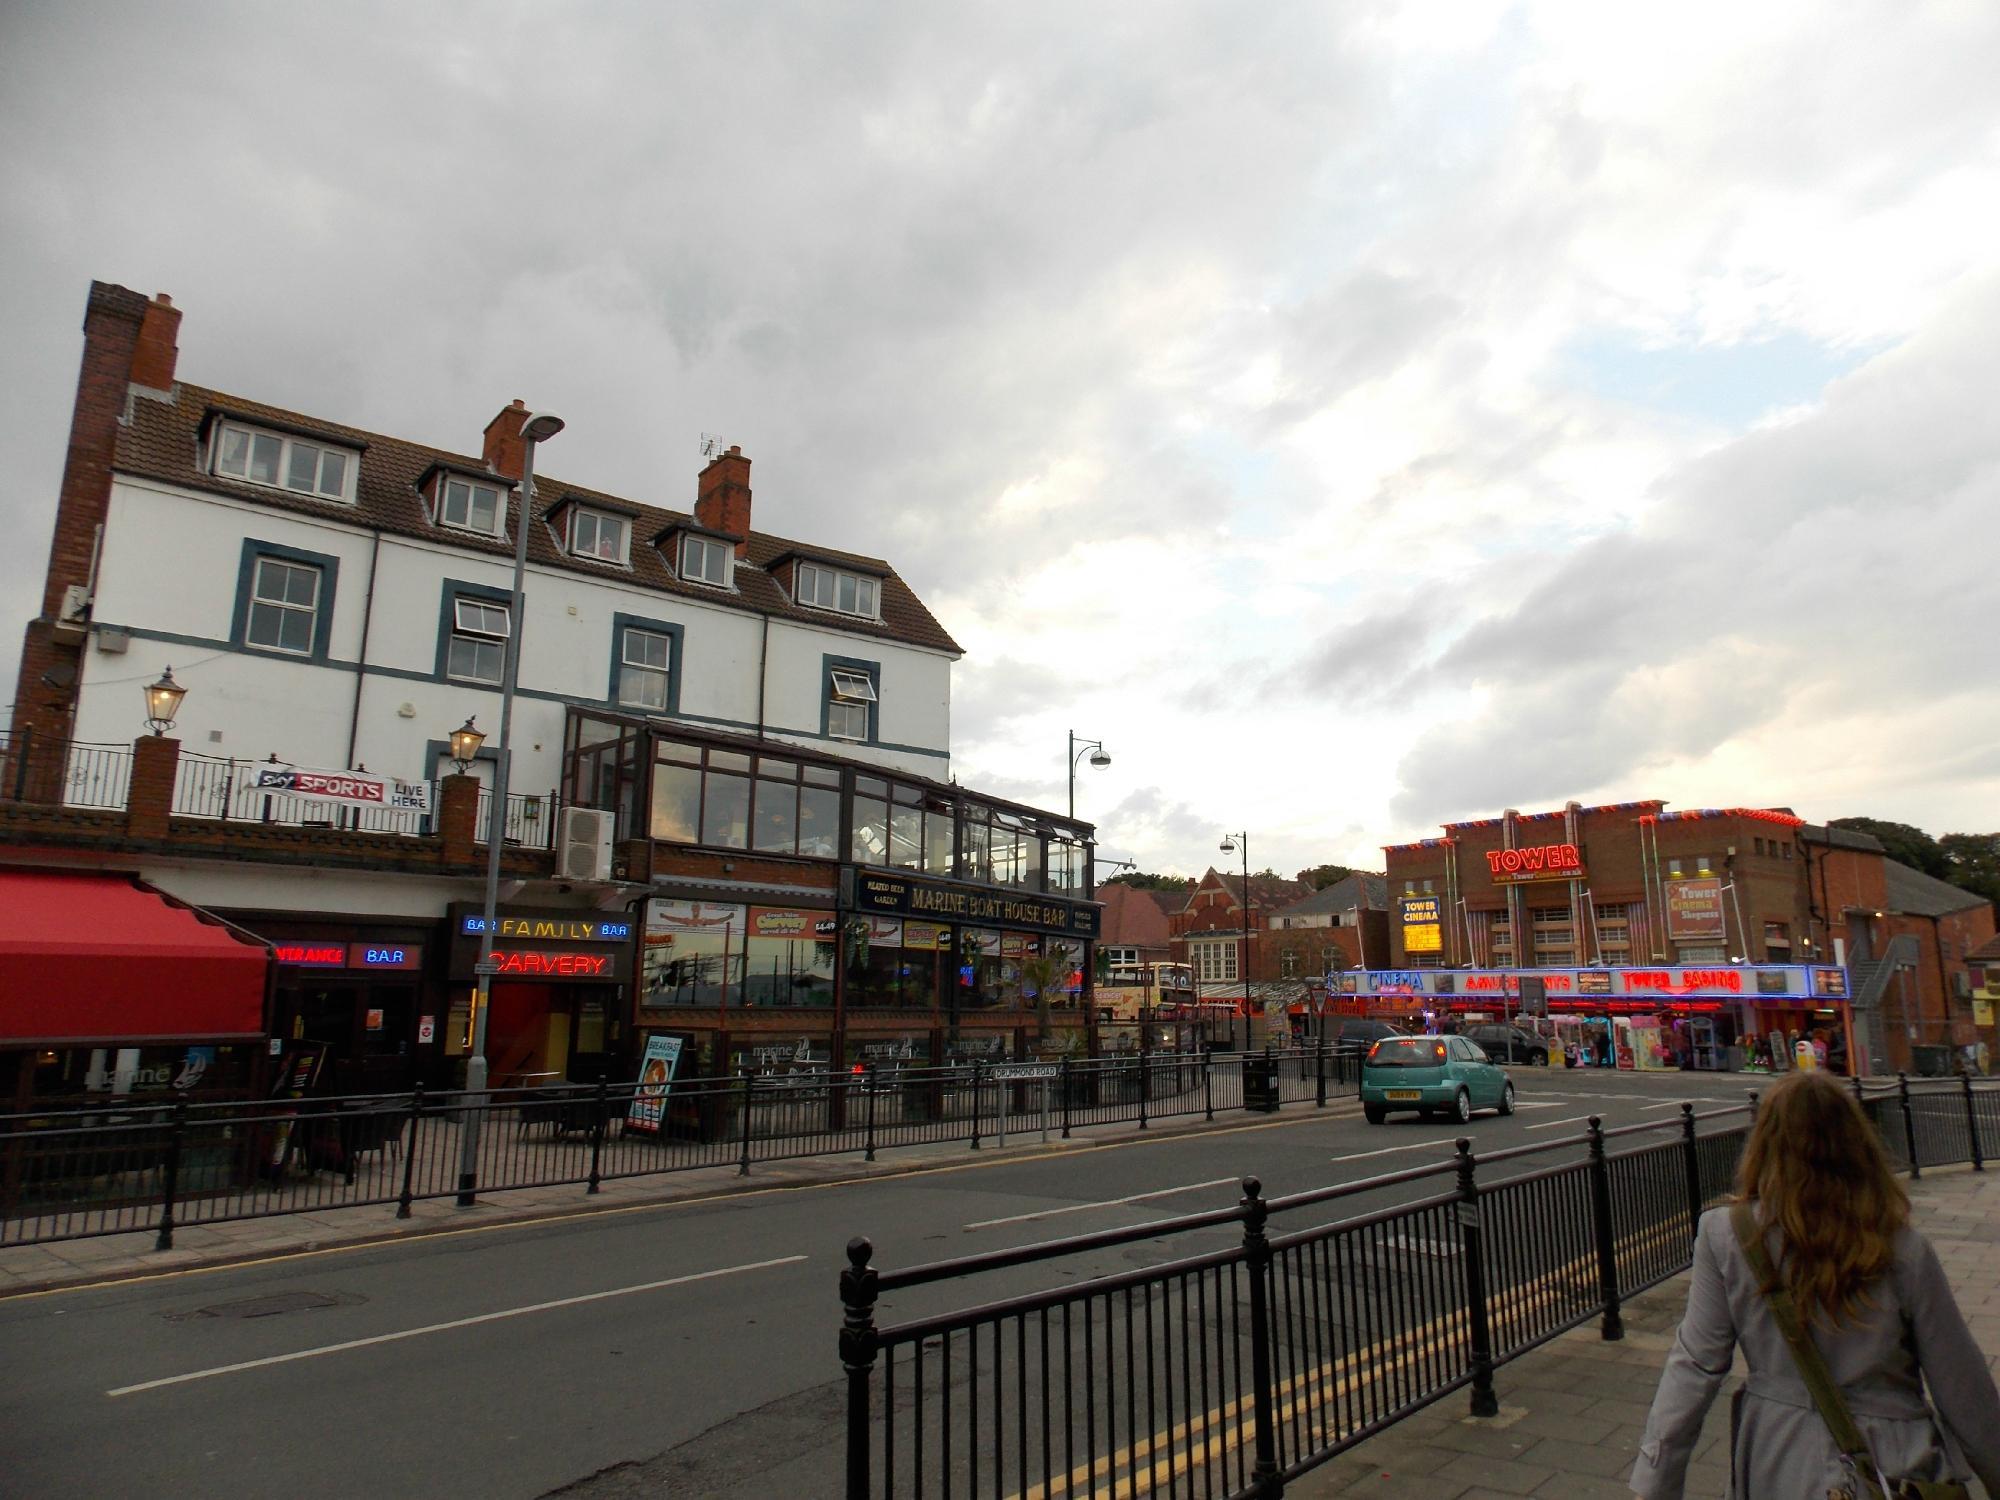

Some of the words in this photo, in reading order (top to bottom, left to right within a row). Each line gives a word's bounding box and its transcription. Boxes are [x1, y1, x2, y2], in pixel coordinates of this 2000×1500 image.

[263, 774, 295, 789] sky
[299, 776, 380, 799] SPORTS
[395, 783, 423, 797] LIVE
[392, 796, 426, 809] HERE
[1486, 844, 1579, 872] TOWER
[1679, 886, 1717, 899] Tower
[911, 887, 965, 914] MARINE
[969, 896, 1001, 918] BOAT
[1005, 901, 1040, 922] HOUSE
[1043, 907, 1066, 928] BAR
[1405, 901, 1436, 911] TOWER
[1403, 911, 1438, 921] CINEMA
[503, 920, 594, 939] FAMILY
[602, 924, 627, 936] BAR
[276, 946, 343, 963] NTRANCE
[367, 950, 404, 963] BAR
[489, 951, 606, 974] CARVERY
[1367, 971, 1424, 991] CINEMA
[1621, 972, 1670, 992] TOWER
[1682, 970, 1742, 993] CASINO
[649, 1041, 681, 1053] BREAKFAST
[752, 1044, 793, 1057] marine
[996, 1068, 1035, 1078] DRUMMOND
[1036, 1067, 1056, 1077] ROAD
